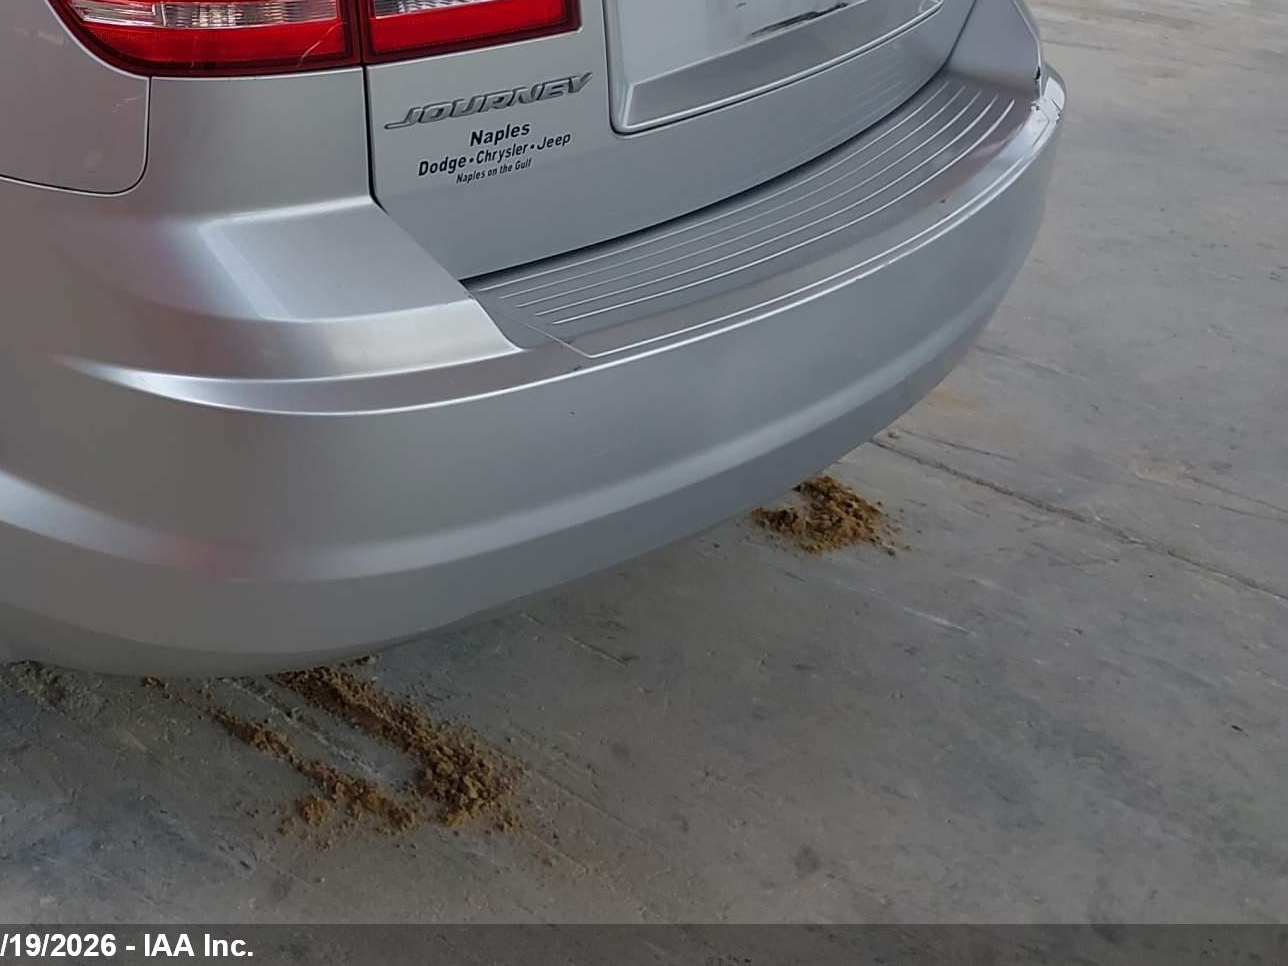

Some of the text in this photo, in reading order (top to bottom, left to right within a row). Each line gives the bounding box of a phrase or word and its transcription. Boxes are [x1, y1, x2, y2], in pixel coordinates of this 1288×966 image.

[384, 72, 593, 130] JOURNEY
[470, 123, 530, 146] Naples
[456, 158, 532, 184] Naples on the Gulf
